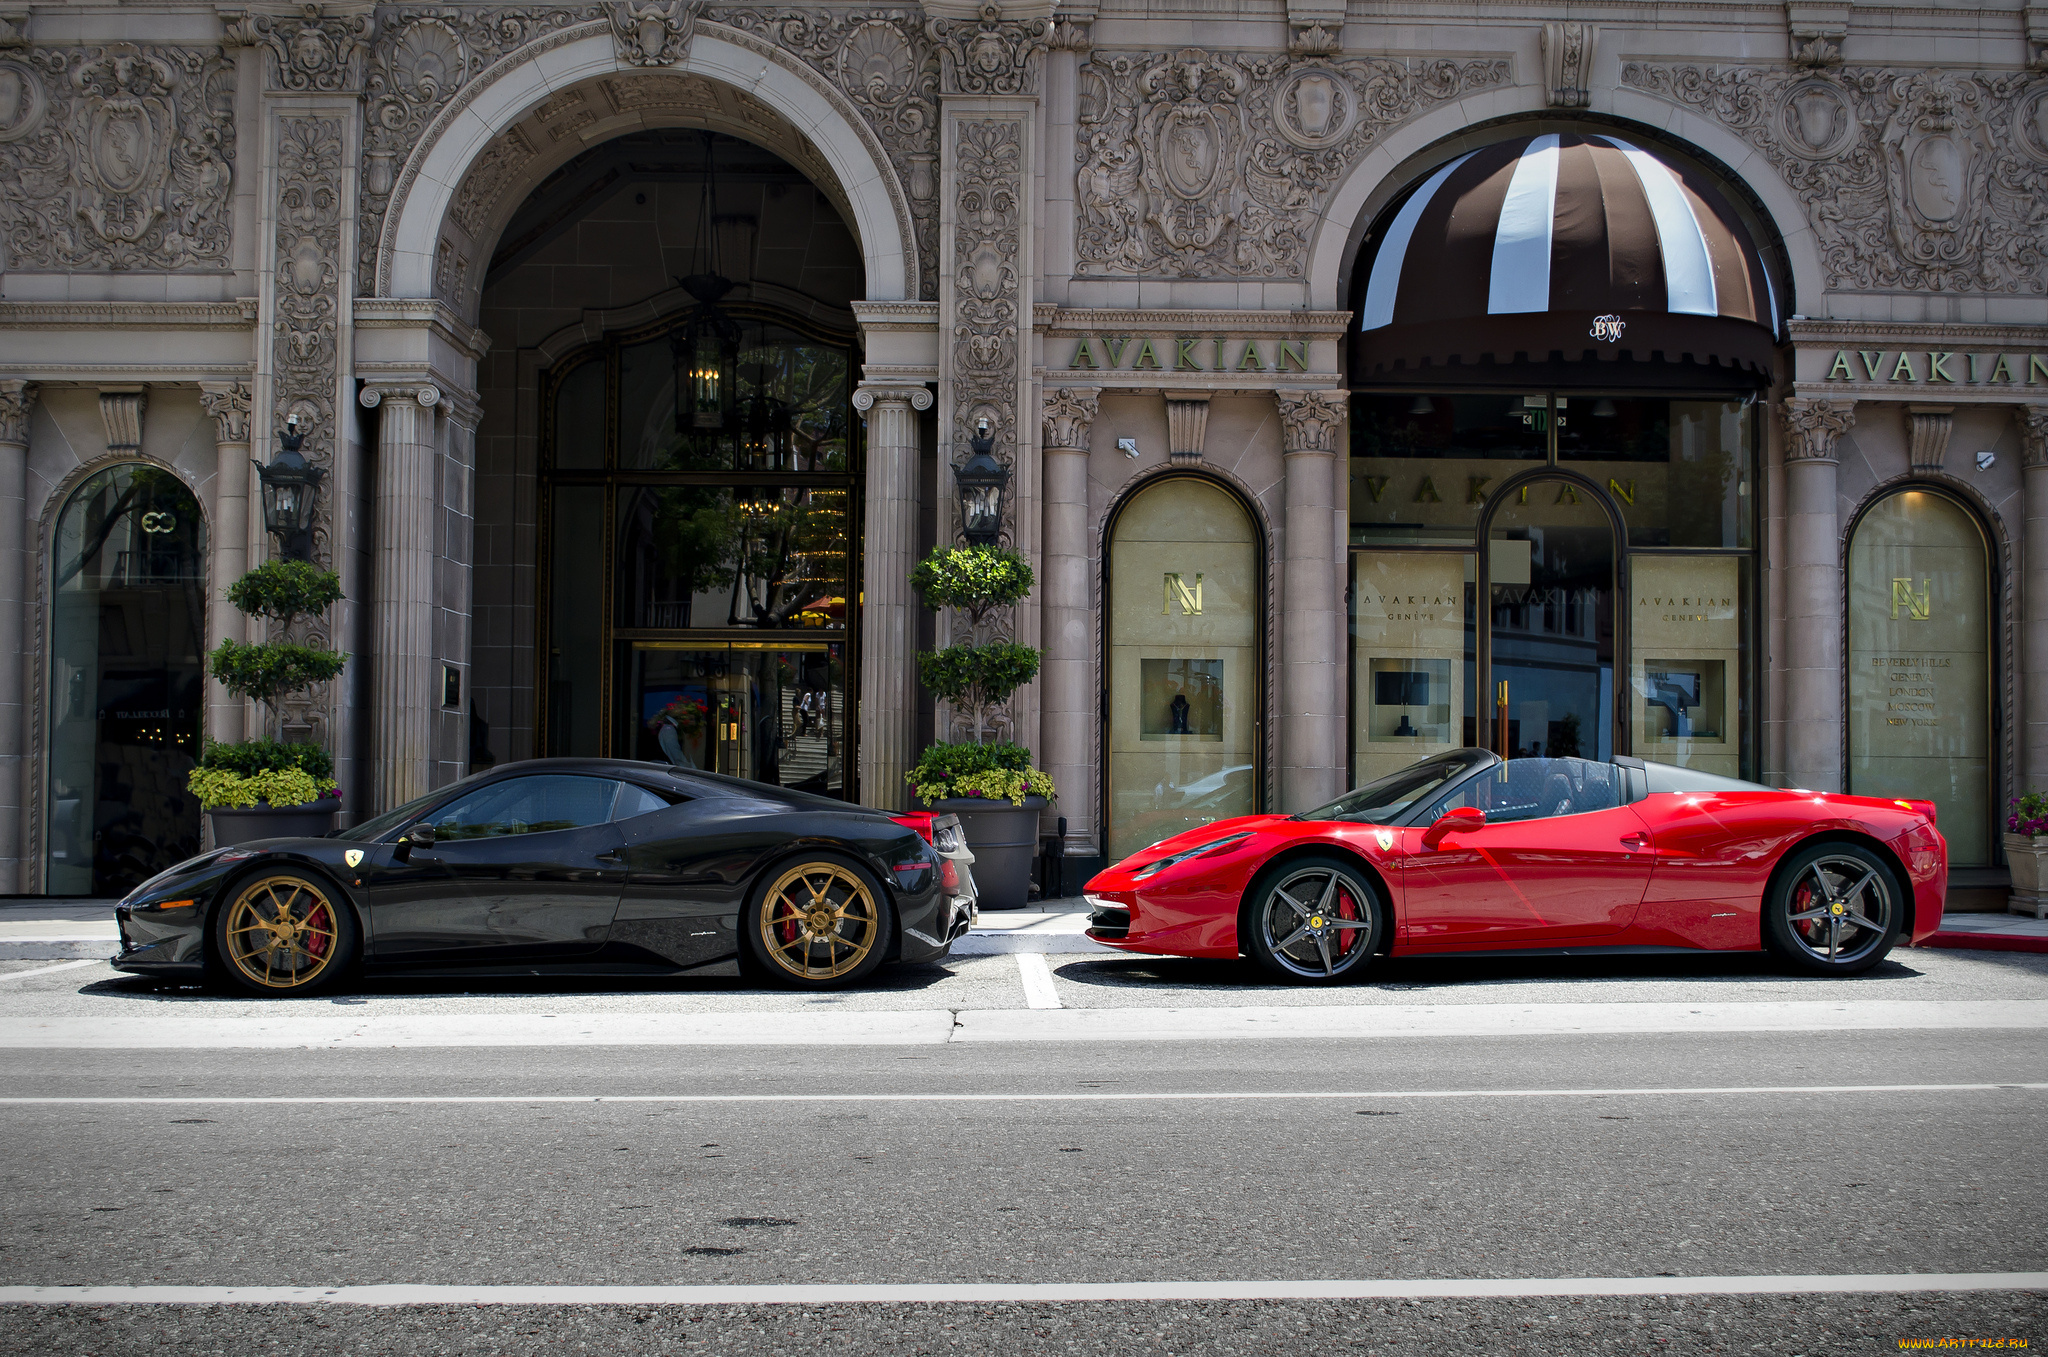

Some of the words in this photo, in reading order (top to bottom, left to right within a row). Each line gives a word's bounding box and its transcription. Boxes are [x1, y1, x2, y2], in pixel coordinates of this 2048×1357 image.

[1069, 338, 1310, 372] AVAKIAN
[1825, 350, 2048, 384] AVAKIAN
[1365, 474, 1636, 507] VAKIAN
[1363, 595, 1457, 606] AVAKIAN
[1500, 588, 1601, 605] AVAKIAN
[1639, 597, 1731, 607] AVAKIAN
[1871, 657, 1919, 667] BEVERLY
[1921, 658, 1951, 668] HILLS
[1890, 672, 1933, 682] GENEVA
[1889, 687, 1935, 697] LONDON
[1887, 702, 1936, 712] MOSCOW
[1885, 717, 1908, 727] NEW
[1911, 718, 1938, 727] YORK
